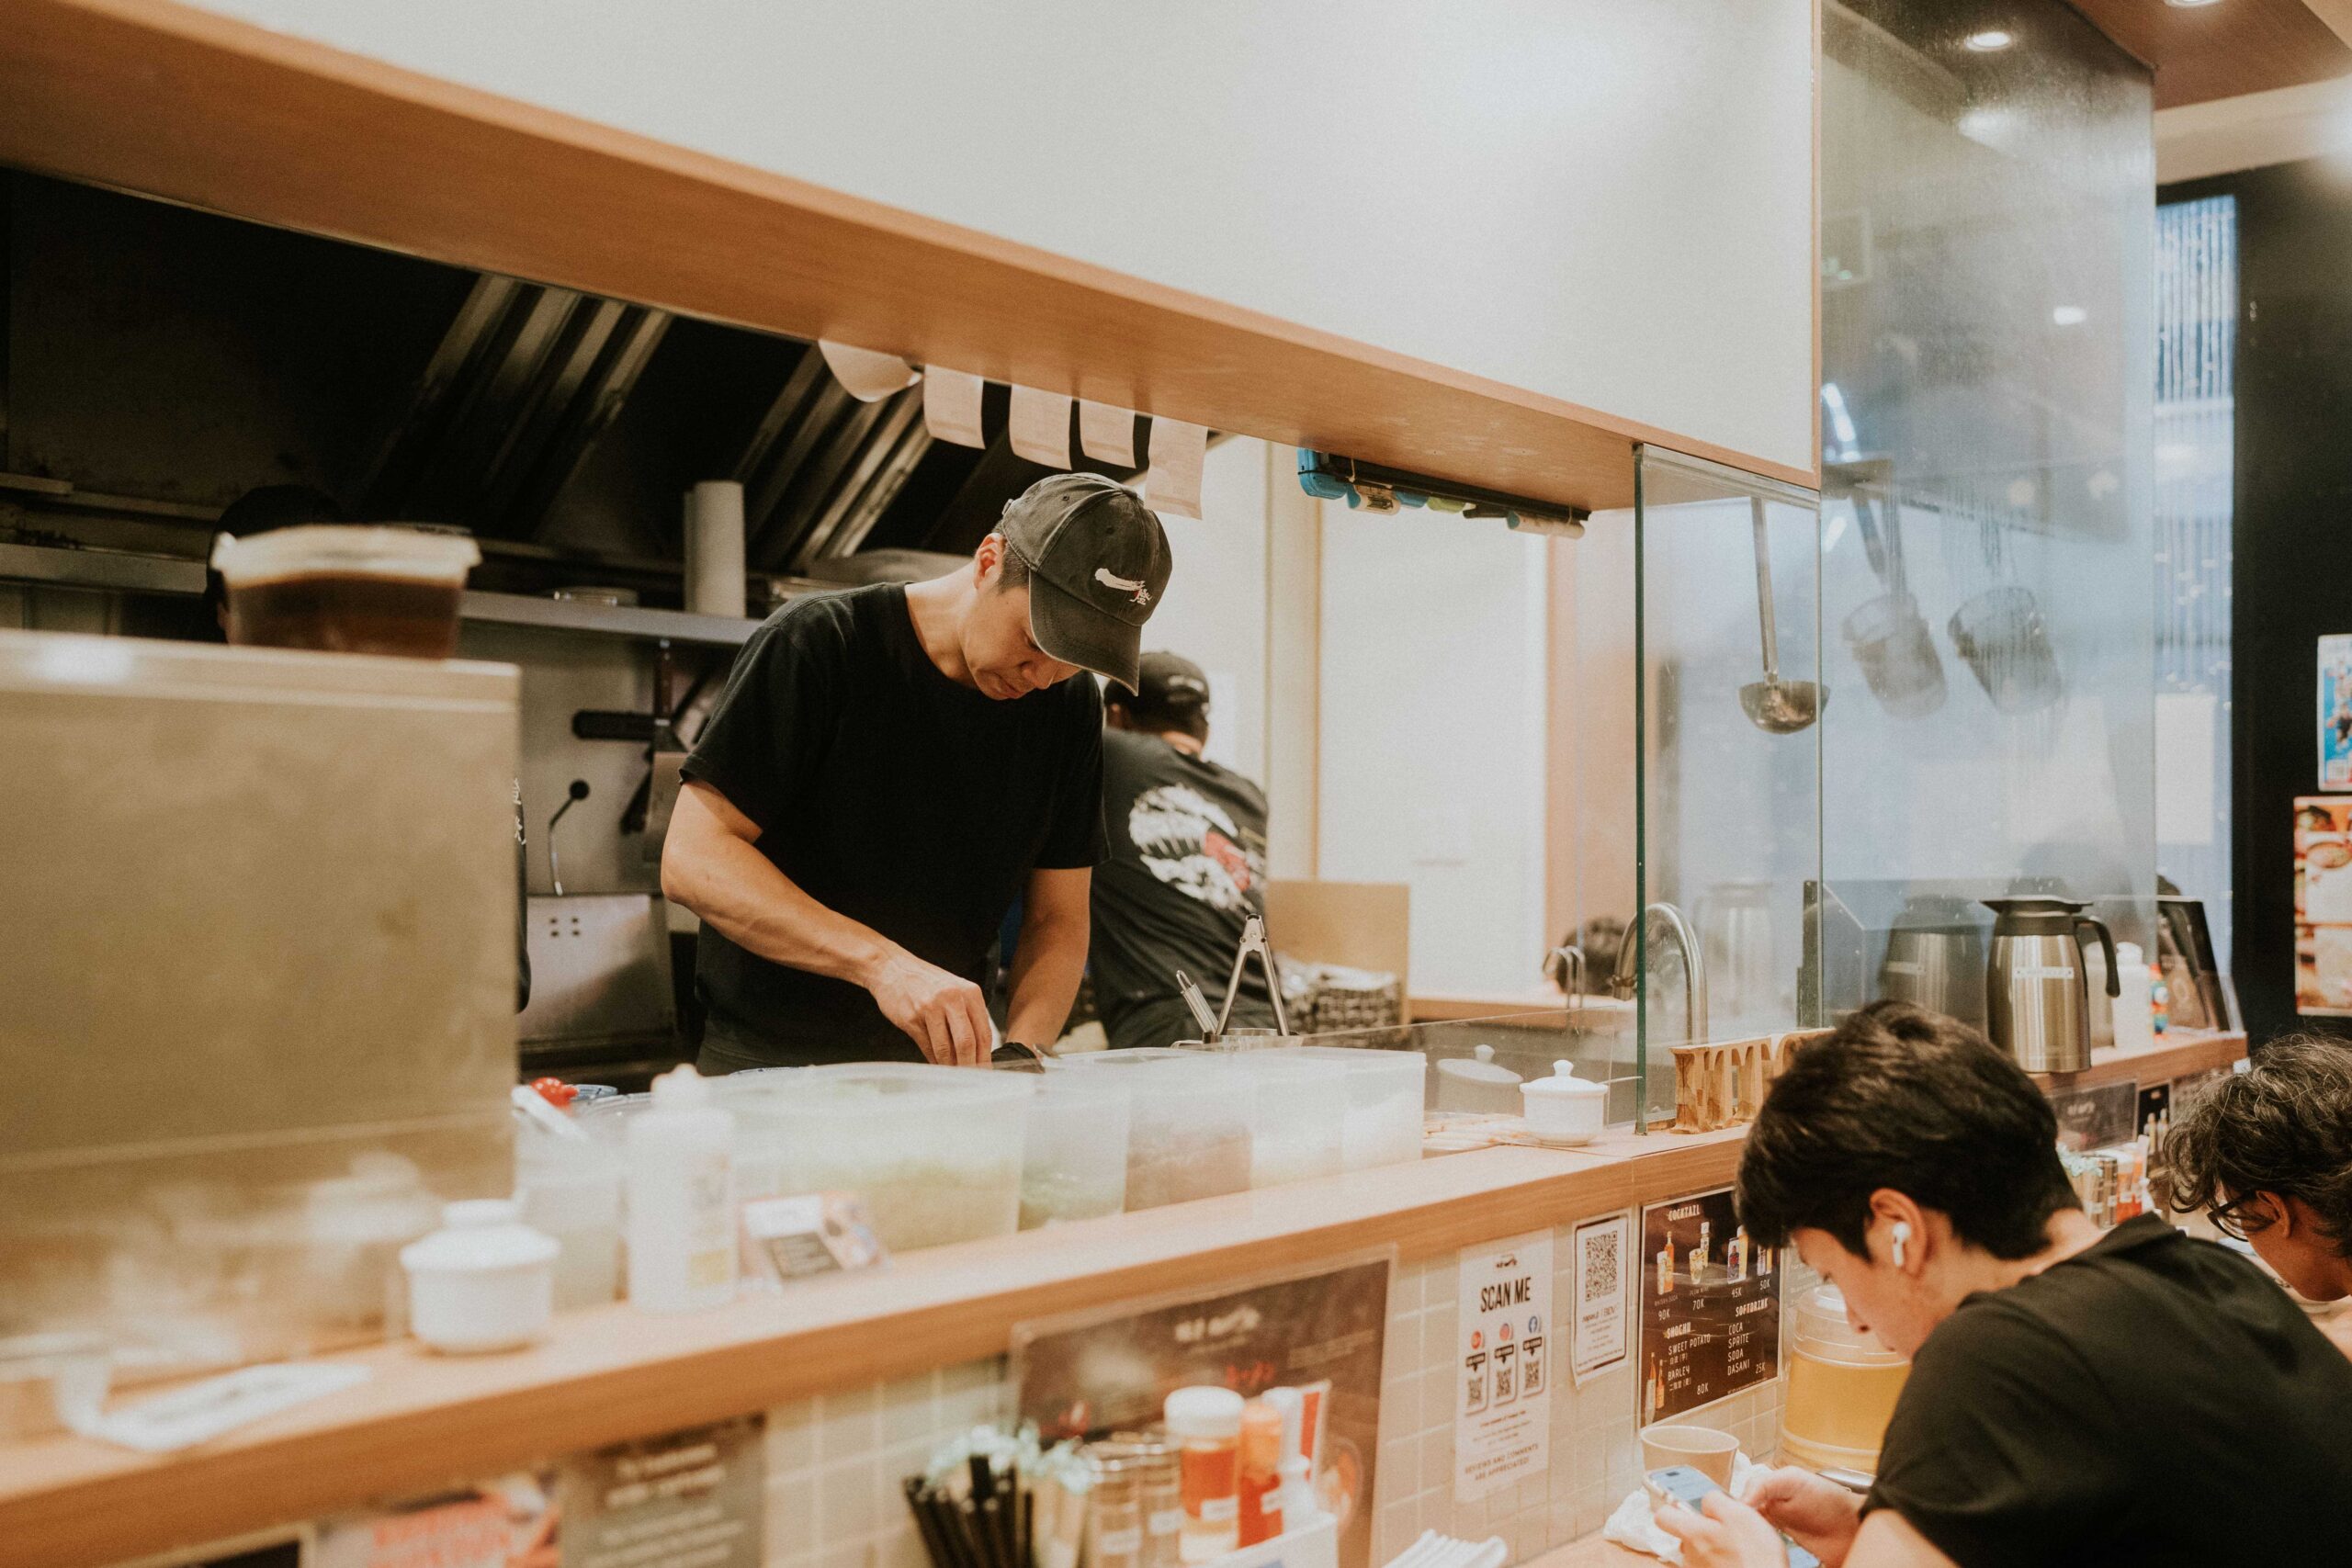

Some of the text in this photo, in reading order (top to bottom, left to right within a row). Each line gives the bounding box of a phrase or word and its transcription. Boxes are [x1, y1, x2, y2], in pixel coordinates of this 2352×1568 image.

[1668, 1204, 1700, 1222] COCKTAIL
[1480, 1276, 1532, 1313] SCAN ME
[1692, 1298, 1704, 1311] 70K
[1736, 1298, 1769, 1317] SOFTDRINK
[1658, 1309, 1670, 1321] 90K
[1667, 1322, 1691, 1339] SHOCHU
[1728, 1322, 1744, 1336] COCA
[1668, 1334, 1711, 1356] SWEET POTATO
[1728, 1333, 1749, 1348] SPRITE
[1728, 1348, 1744, 1362] SODA
[1668, 1365, 1690, 1382] BARLEY
[1727, 1359, 1750, 1376] DASANI
[1697, 1382, 1709, 1395] 80K
